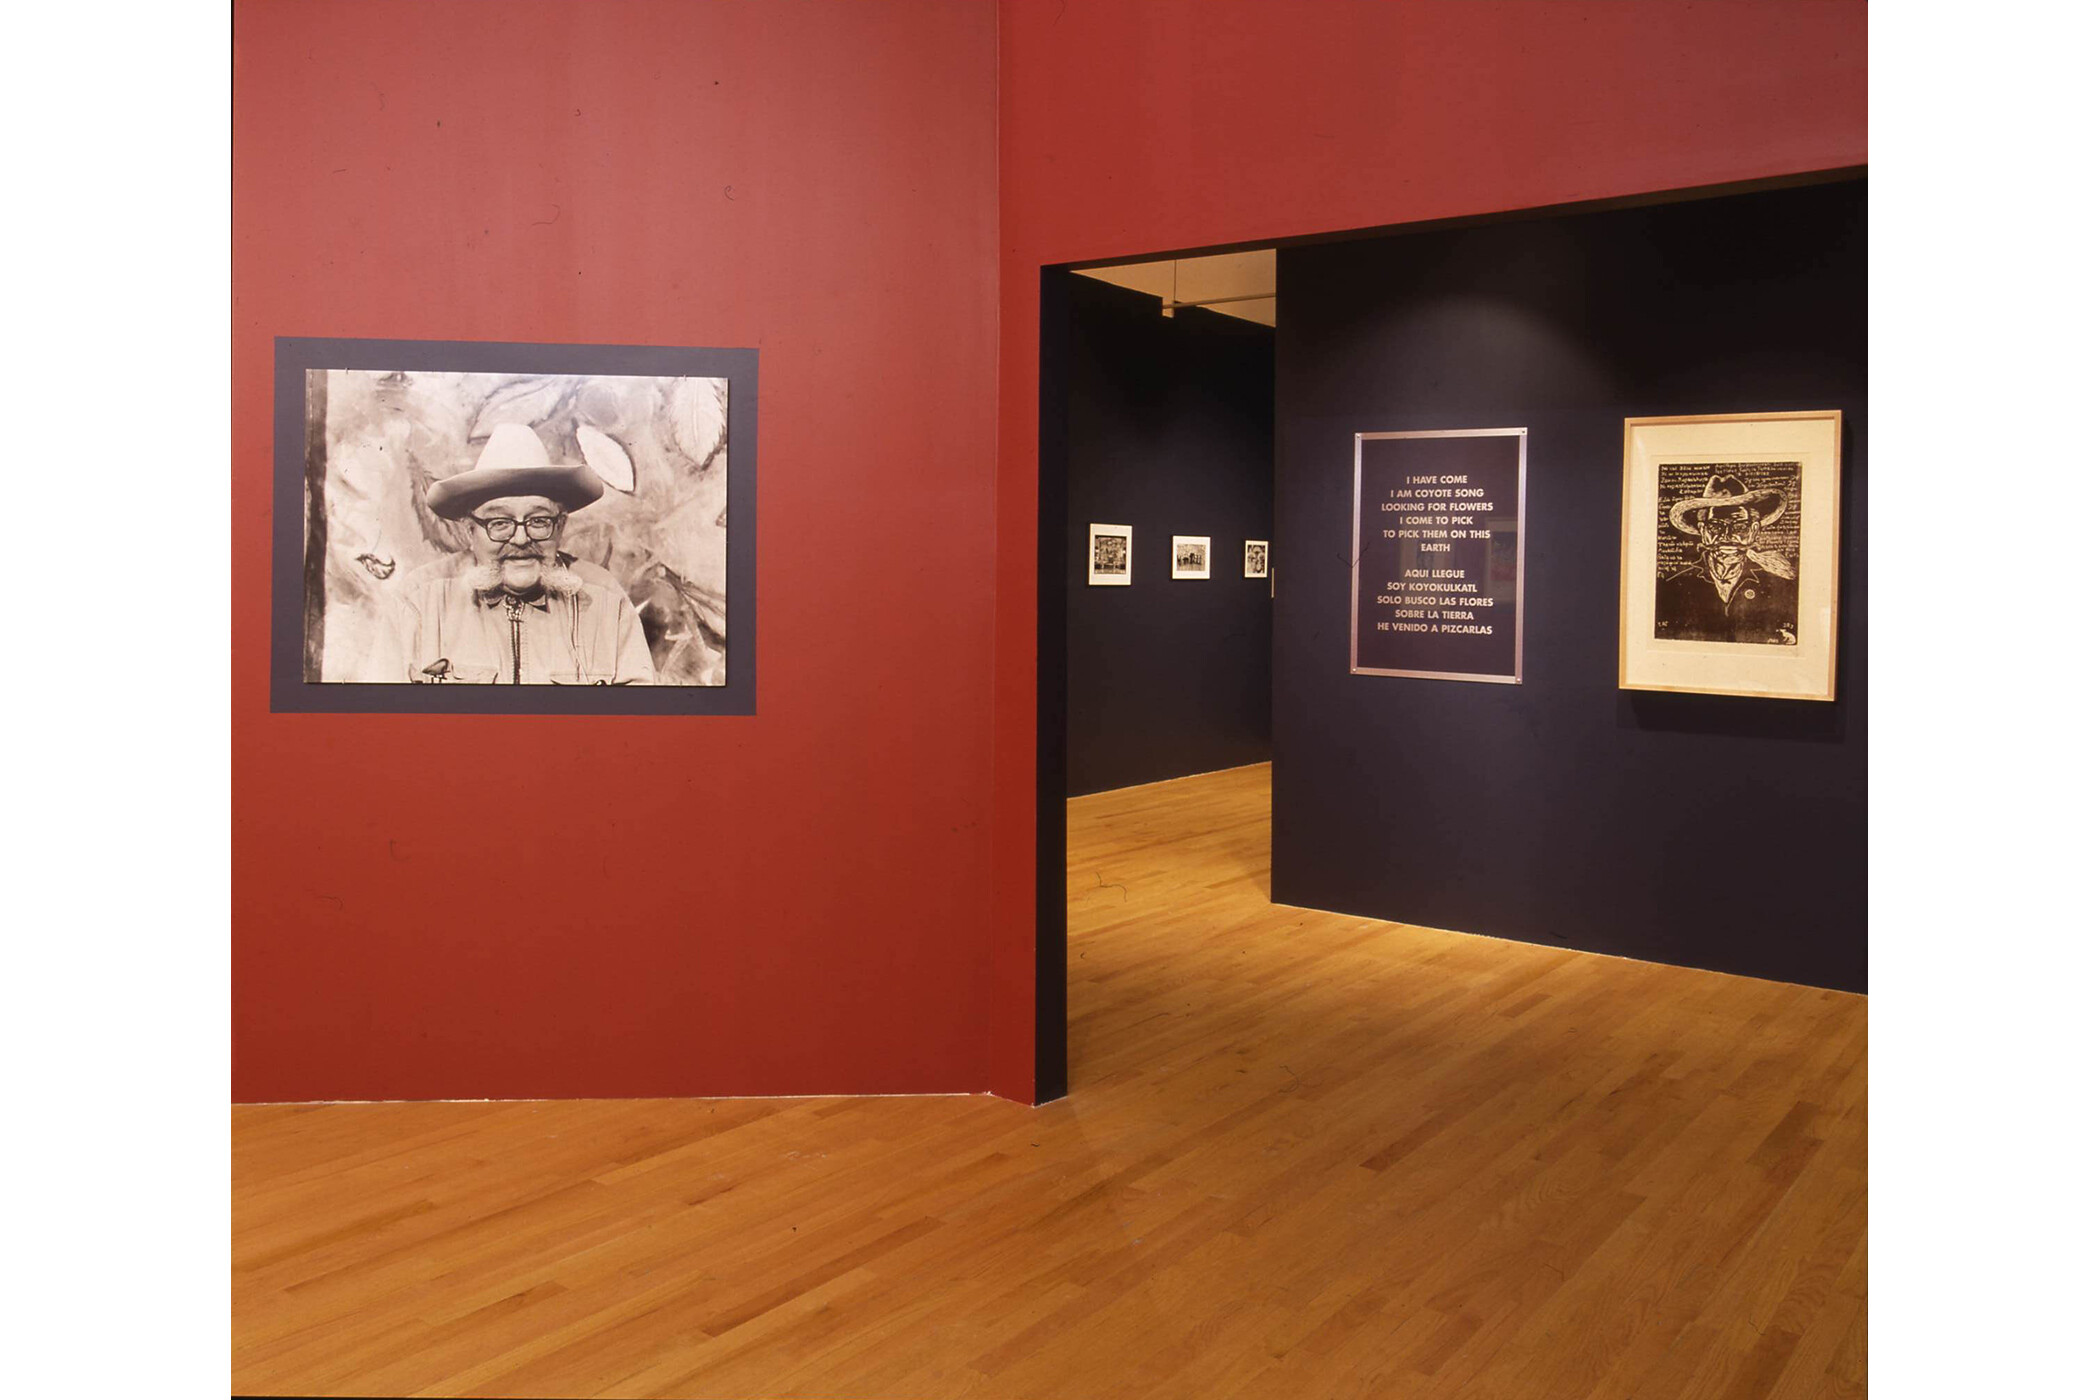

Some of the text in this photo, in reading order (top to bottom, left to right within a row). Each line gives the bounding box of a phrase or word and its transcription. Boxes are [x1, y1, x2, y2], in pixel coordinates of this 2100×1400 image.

[1413, 475, 1437, 484] HAVE
[1440, 475, 1468, 484] COME
[1397, 489, 1412, 498] AM
[1415, 489, 1452, 498] COYOTE
[1455, 489, 1484, 497] SONG
[1381, 502, 1493, 511] LOOKING FOR FLOWERS
[1406, 516, 1433, 525] COME
[1436, 516, 1449, 525] TO
[1452, 516, 1473, 525] PICK
[1383, 530, 1491, 539] TO PICK THEM ON THIS
[1421, 543, 1451, 552] EARTH
[1404, 569, 1465, 578] AQUI LLEGUE
[1387, 582, 1478, 593] SOY KOYOKULKATL
[1377, 596, 1493, 607] SOLO BUSCO LAS FLORES
[1395, 609, 1474, 620] SOBRE LA TIERRA
[1377, 622, 1389, 631] HE
[1392, 622, 1428, 632] VENIDO
[1441, 624, 1492, 635] PIZCARLAS
